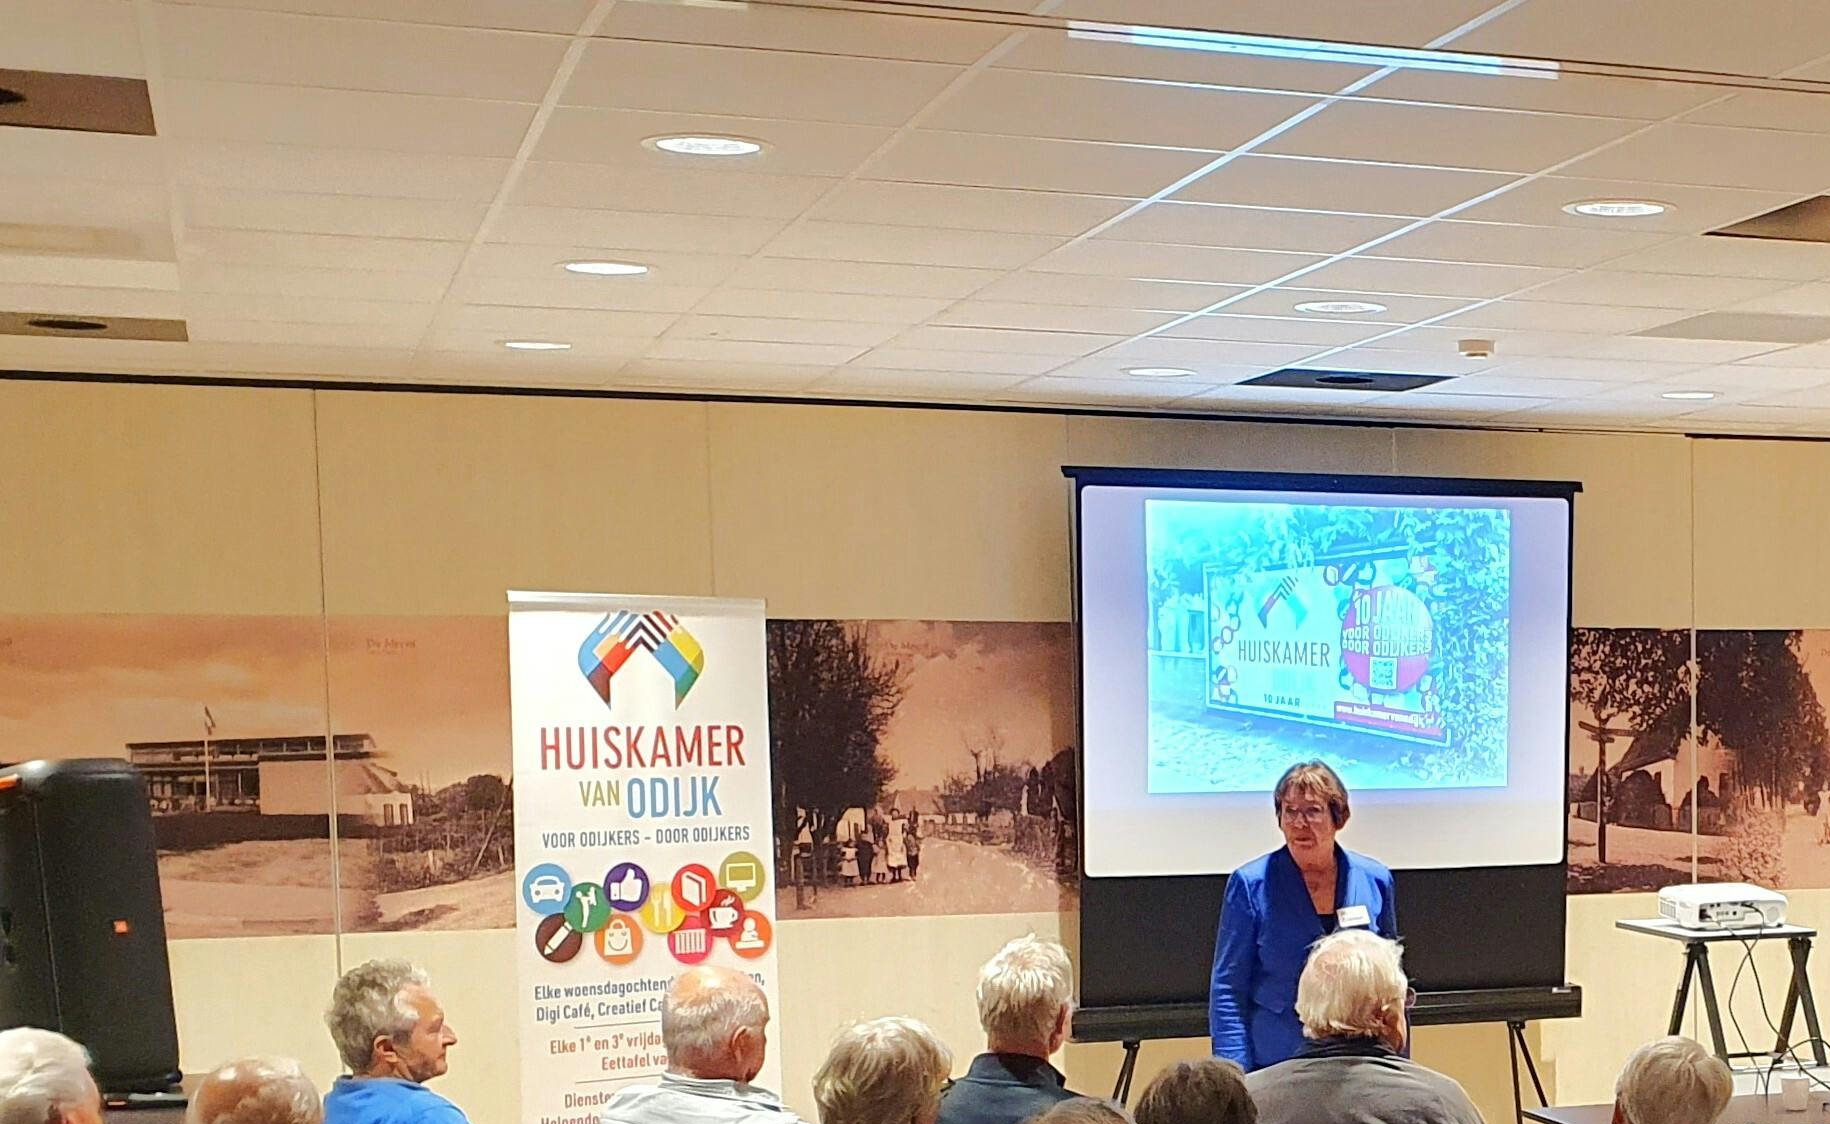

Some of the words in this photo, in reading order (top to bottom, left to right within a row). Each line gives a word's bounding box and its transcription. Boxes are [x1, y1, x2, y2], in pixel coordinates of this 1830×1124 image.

[1238, 640, 1331, 668] HUISKAMER
[1263, 693, 1273, 704] 10
[1275, 695, 1301, 708] JAAR
[540, 725, 747, 770] HUISKAMER
[579, 780, 620, 807] VAN
[626, 776, 723, 819] ODIJK
[542, 831, 576, 848] VOOR
[580, 829, 640, 847] ODIJKERS
[655, 827, 690, 844] DOOR
[693, 825, 751, 842] ODIJKERS
[534, 985, 562, 1001] Elke
[536, 1006, 560, 1024] Digi
[563, 1002, 595, 1021] Café,
[598, 1000, 647, 1017] Creatief
[550, 1039, 577, 1055] Elke
[594, 1039, 609, 1050] en
[626, 1032, 663, 1050] vrijda
[601, 1053, 651, 1071] Eettafel
[653, 1055, 669, 1066] va
